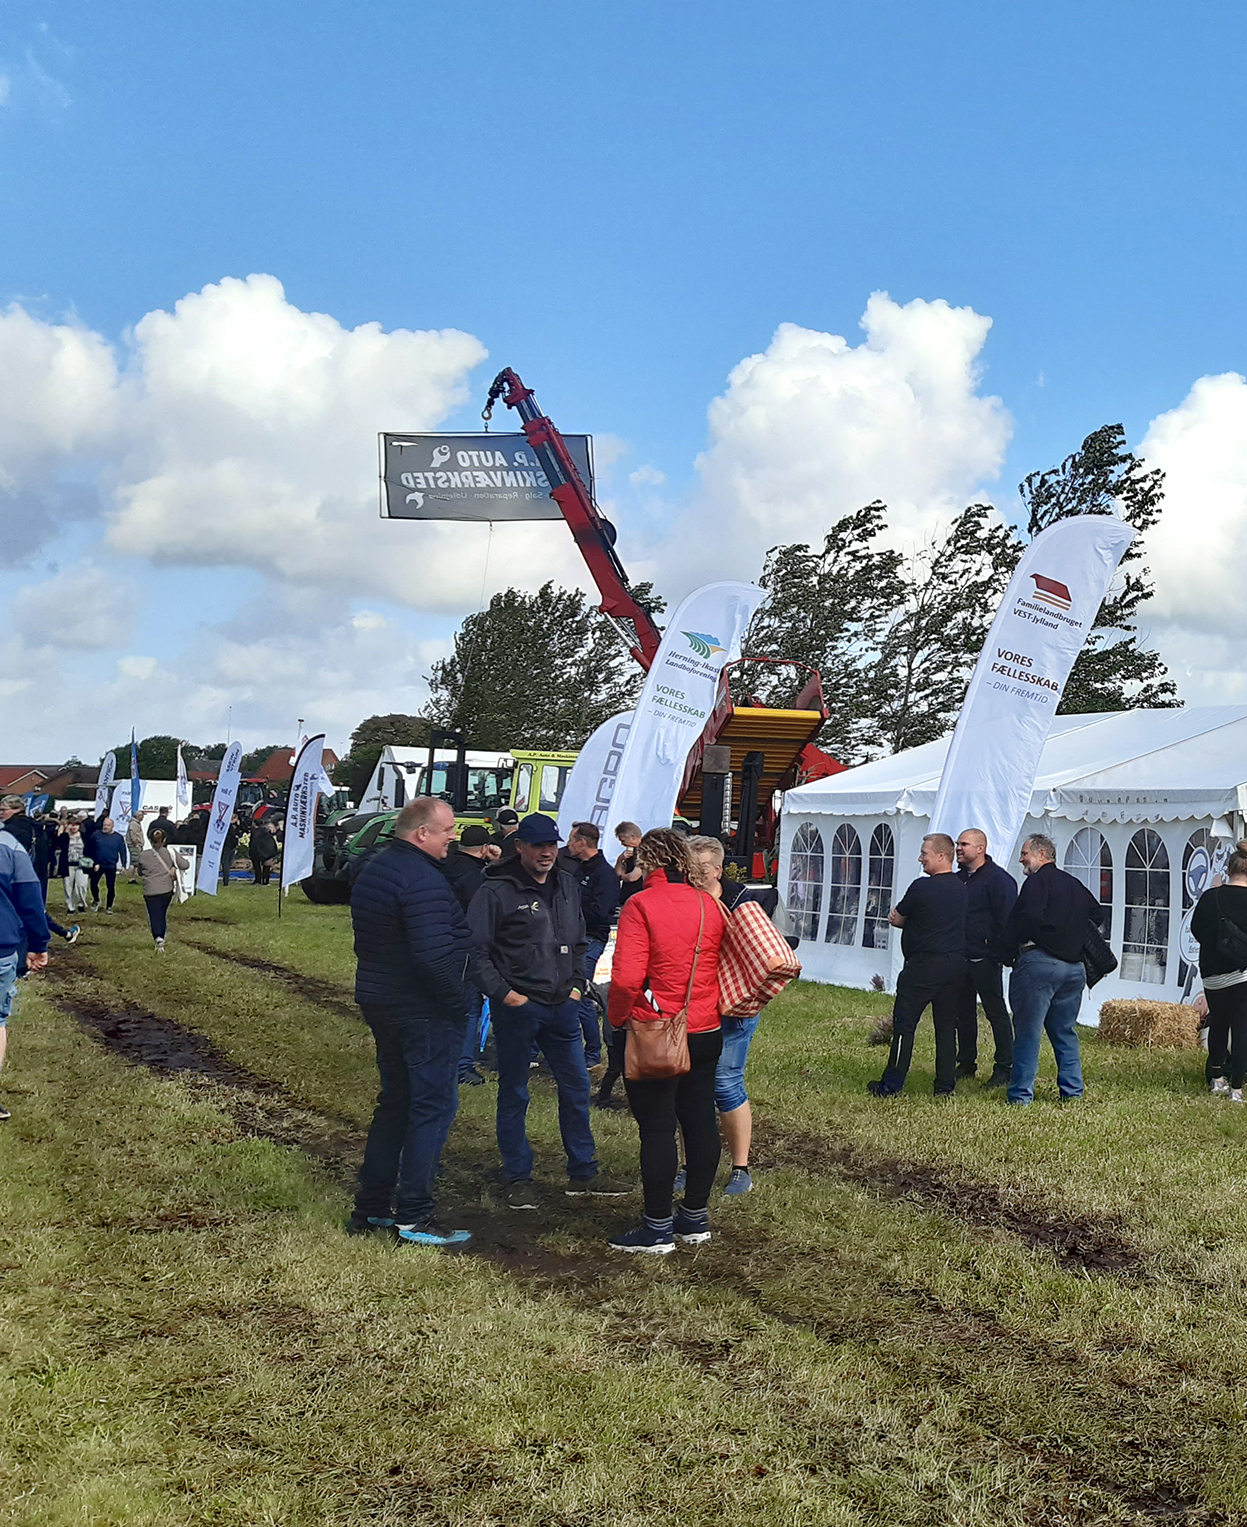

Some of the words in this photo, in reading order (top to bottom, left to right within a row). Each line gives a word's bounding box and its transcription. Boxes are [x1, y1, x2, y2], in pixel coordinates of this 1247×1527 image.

[1012, 607, 1060, 631] VEST-Jylland
[1016, 597, 1083, 629] Familielandbruget
[668, 650, 720, 674] Herning-Ikast
[997, 648, 1034, 668] VORES
[665, 659, 718, 684] Landboforening
[991, 662, 1060, 692] FÆLLESSKAB
[655, 684, 686, 700] VORES
[992, 681, 1010, 694] DIN
[1010, 684, 1049, 704] FREMTID
[651, 695, 706, 719] FÆLLESSKAB
[653, 709, 667, 721] DIN
[666, 712, 697, 728] FREMTID
